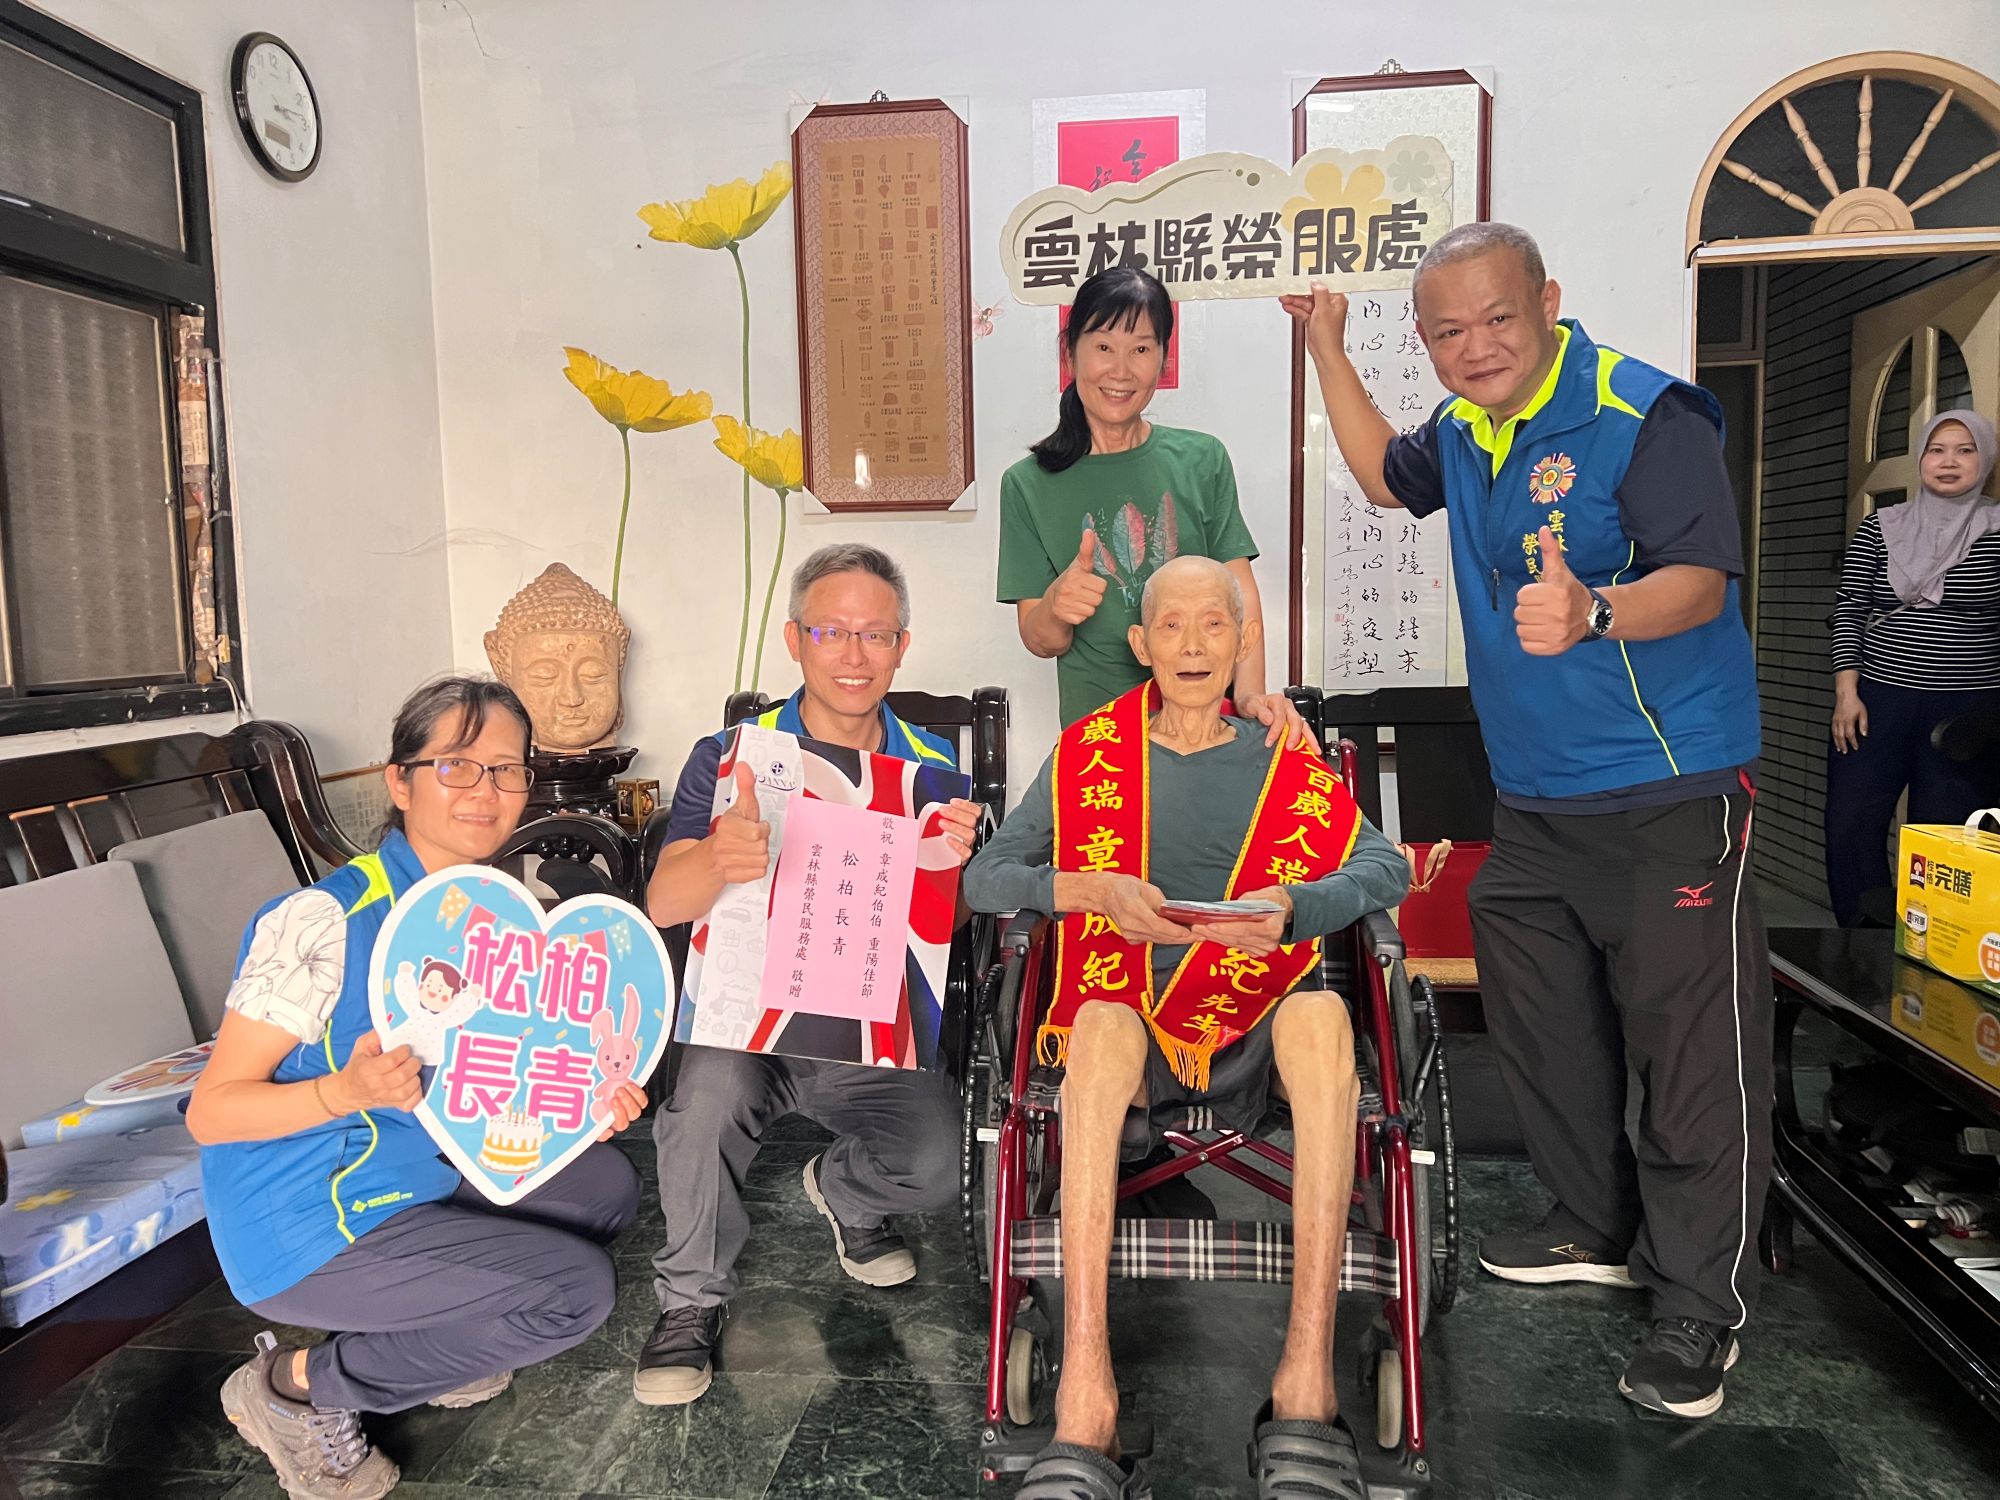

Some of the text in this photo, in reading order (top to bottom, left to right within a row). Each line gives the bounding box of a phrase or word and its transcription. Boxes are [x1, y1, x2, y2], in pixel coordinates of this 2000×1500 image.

[1023, 198, 1428, 289] 雲林縣榮服處
[788, 843, 824, 999] 雲林縣榮民服務處 敬贈
[832, 849, 860, 956] 松柏長青
[861, 816, 895, 999] 敬祝 章成紀伯伯 重陽佳節
[464, 926, 609, 1024] 松柏
[446, 1034, 594, 1130] 長青
